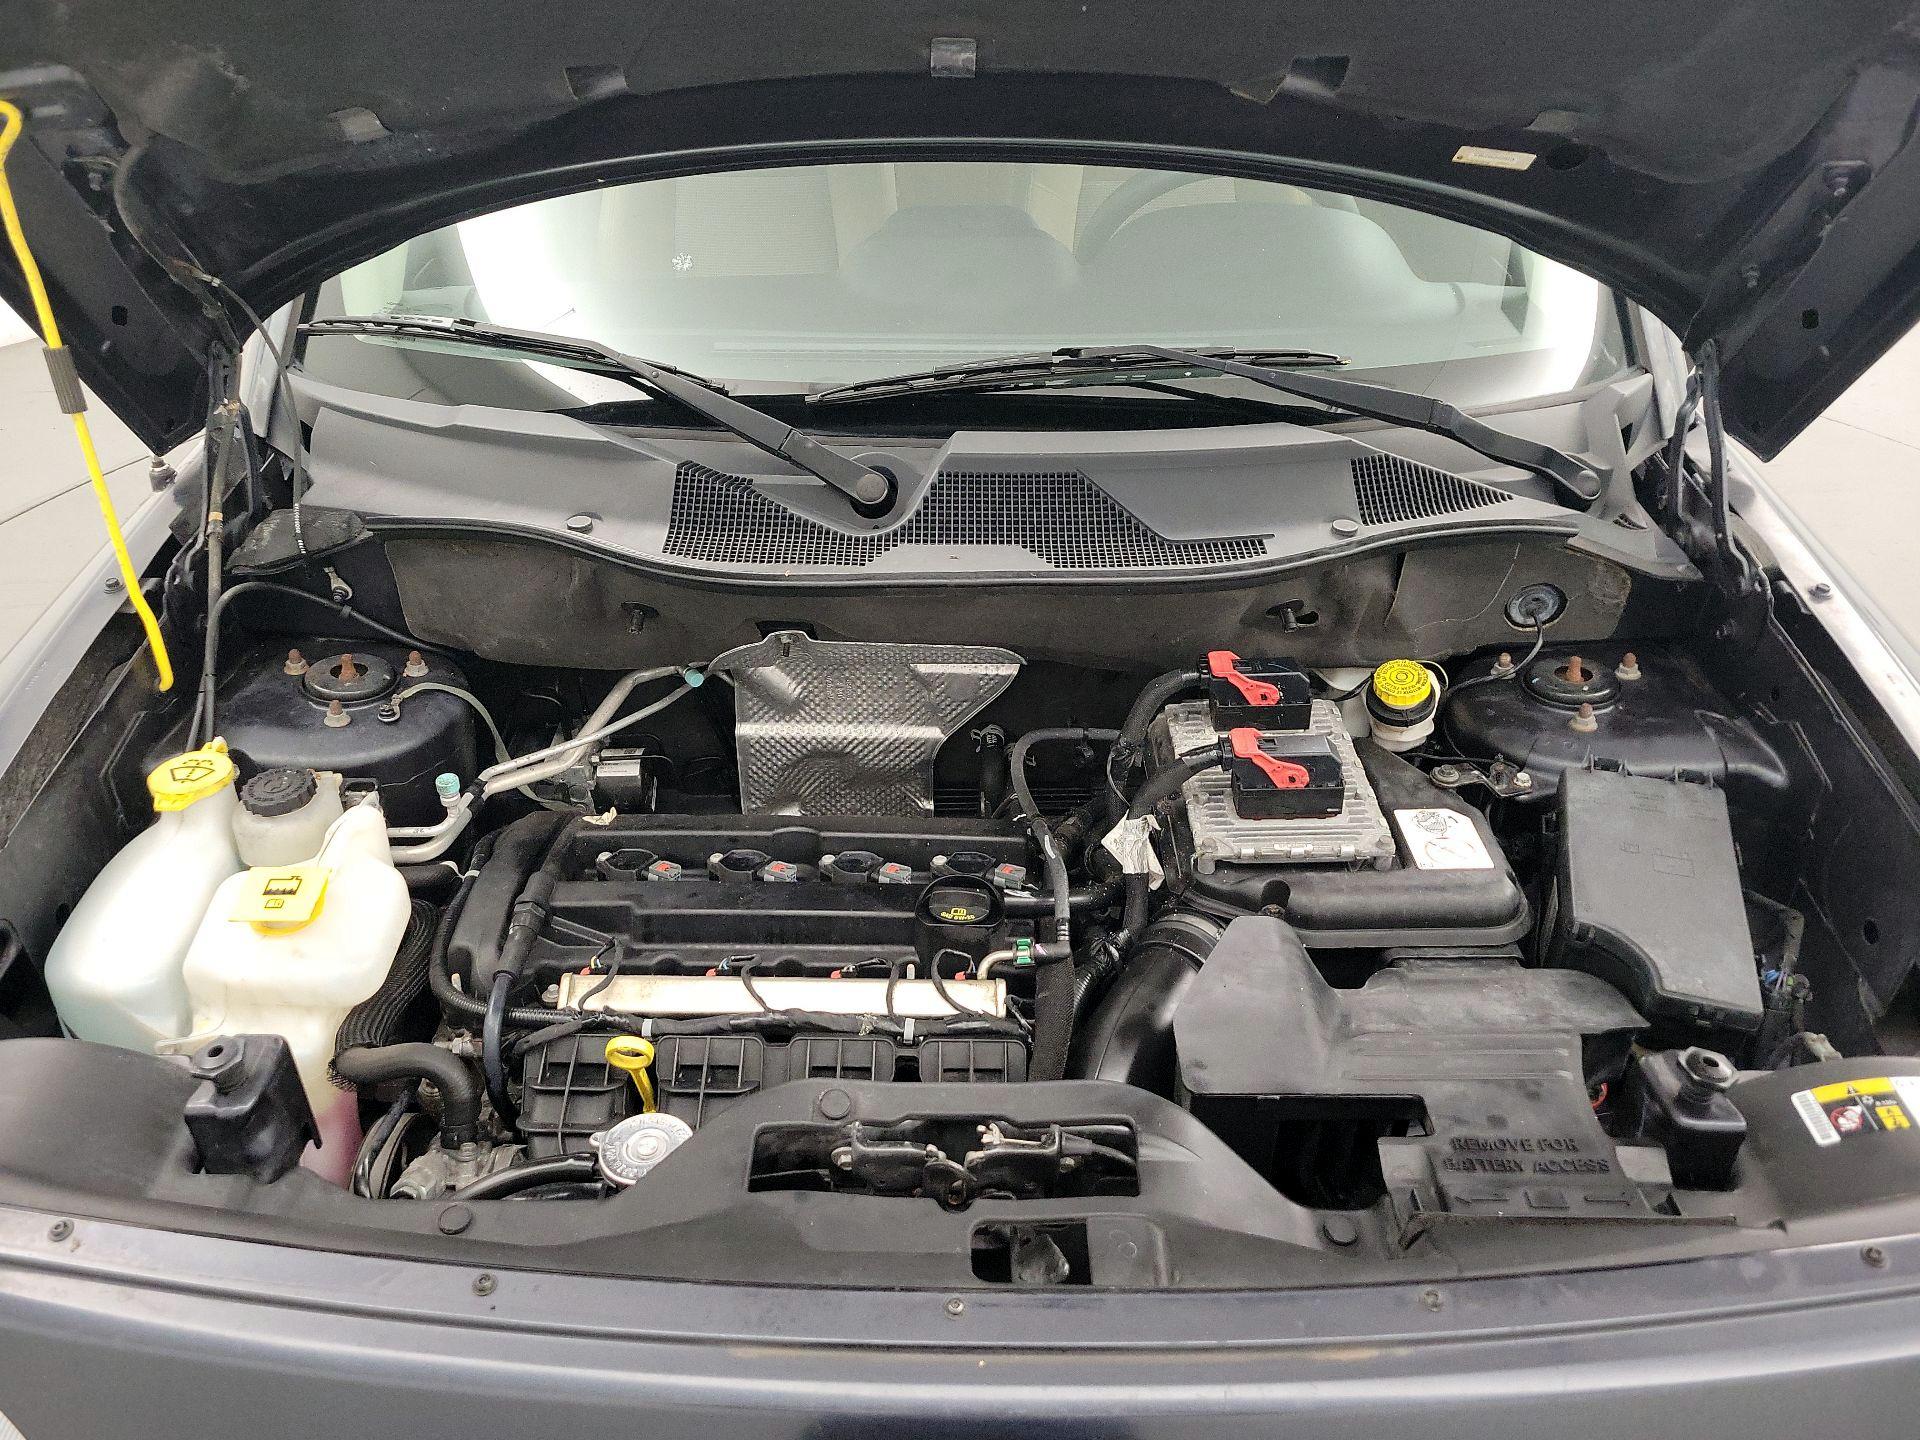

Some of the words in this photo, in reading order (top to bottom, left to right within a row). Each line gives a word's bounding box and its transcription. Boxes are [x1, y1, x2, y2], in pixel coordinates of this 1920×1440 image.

[1449, 1136, 1534, 1153] REMOVE
[1536, 1138, 1579, 1153] FOR
[1443, 1158, 1525, 1173] BATTERY
[1533, 1158, 1611, 1174] ACCESS
